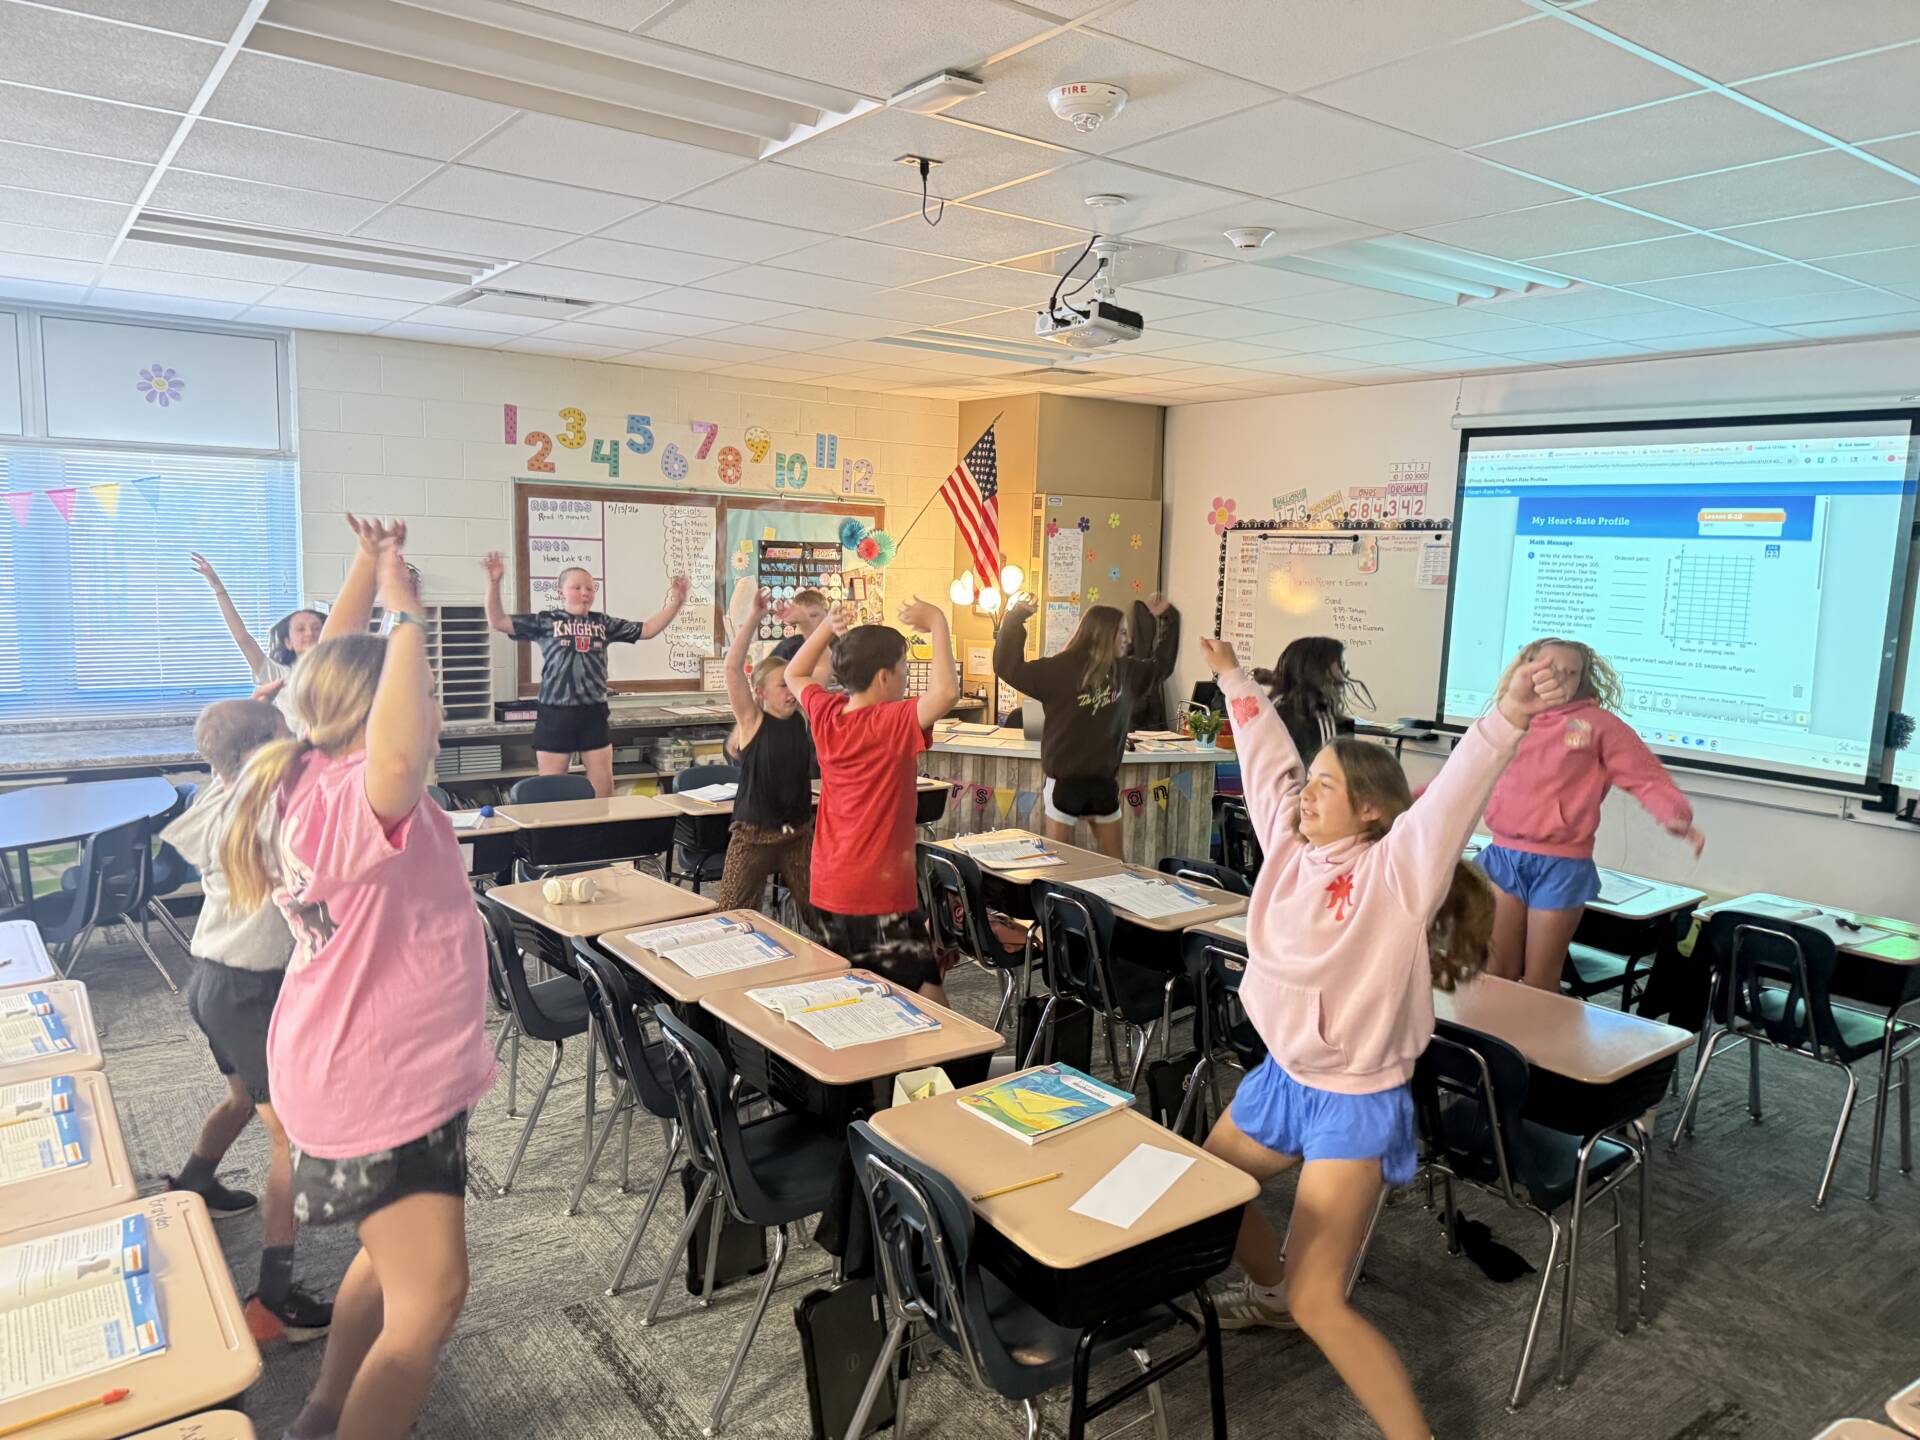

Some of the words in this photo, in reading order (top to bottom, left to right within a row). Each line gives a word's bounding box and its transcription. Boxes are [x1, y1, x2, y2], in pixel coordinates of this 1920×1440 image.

[1062, 85, 1087, 95] FIRE
[504, 404, 517, 444] 1
[525, 432, 556, 473] 2
[557, 408, 587, 449] 3
[591, 439, 619, 477] 4
[626, 414, 654, 454] 5
[661, 442, 688, 480] 6
[693, 421, 718, 459] 7
[718, 446, 742, 484] 8
[744, 426, 771, 463] 9
[775, 452, 808, 489] 10
[816, 433, 838, 469] 11
[842, 458, 874, 494] 12
[1532, 517, 1545, 526] My
[1548, 517, 1596, 525] Heart-Rate
[1598, 517, 1630, 526] Profile
[553, 620, 606, 640] KNIGHTS
